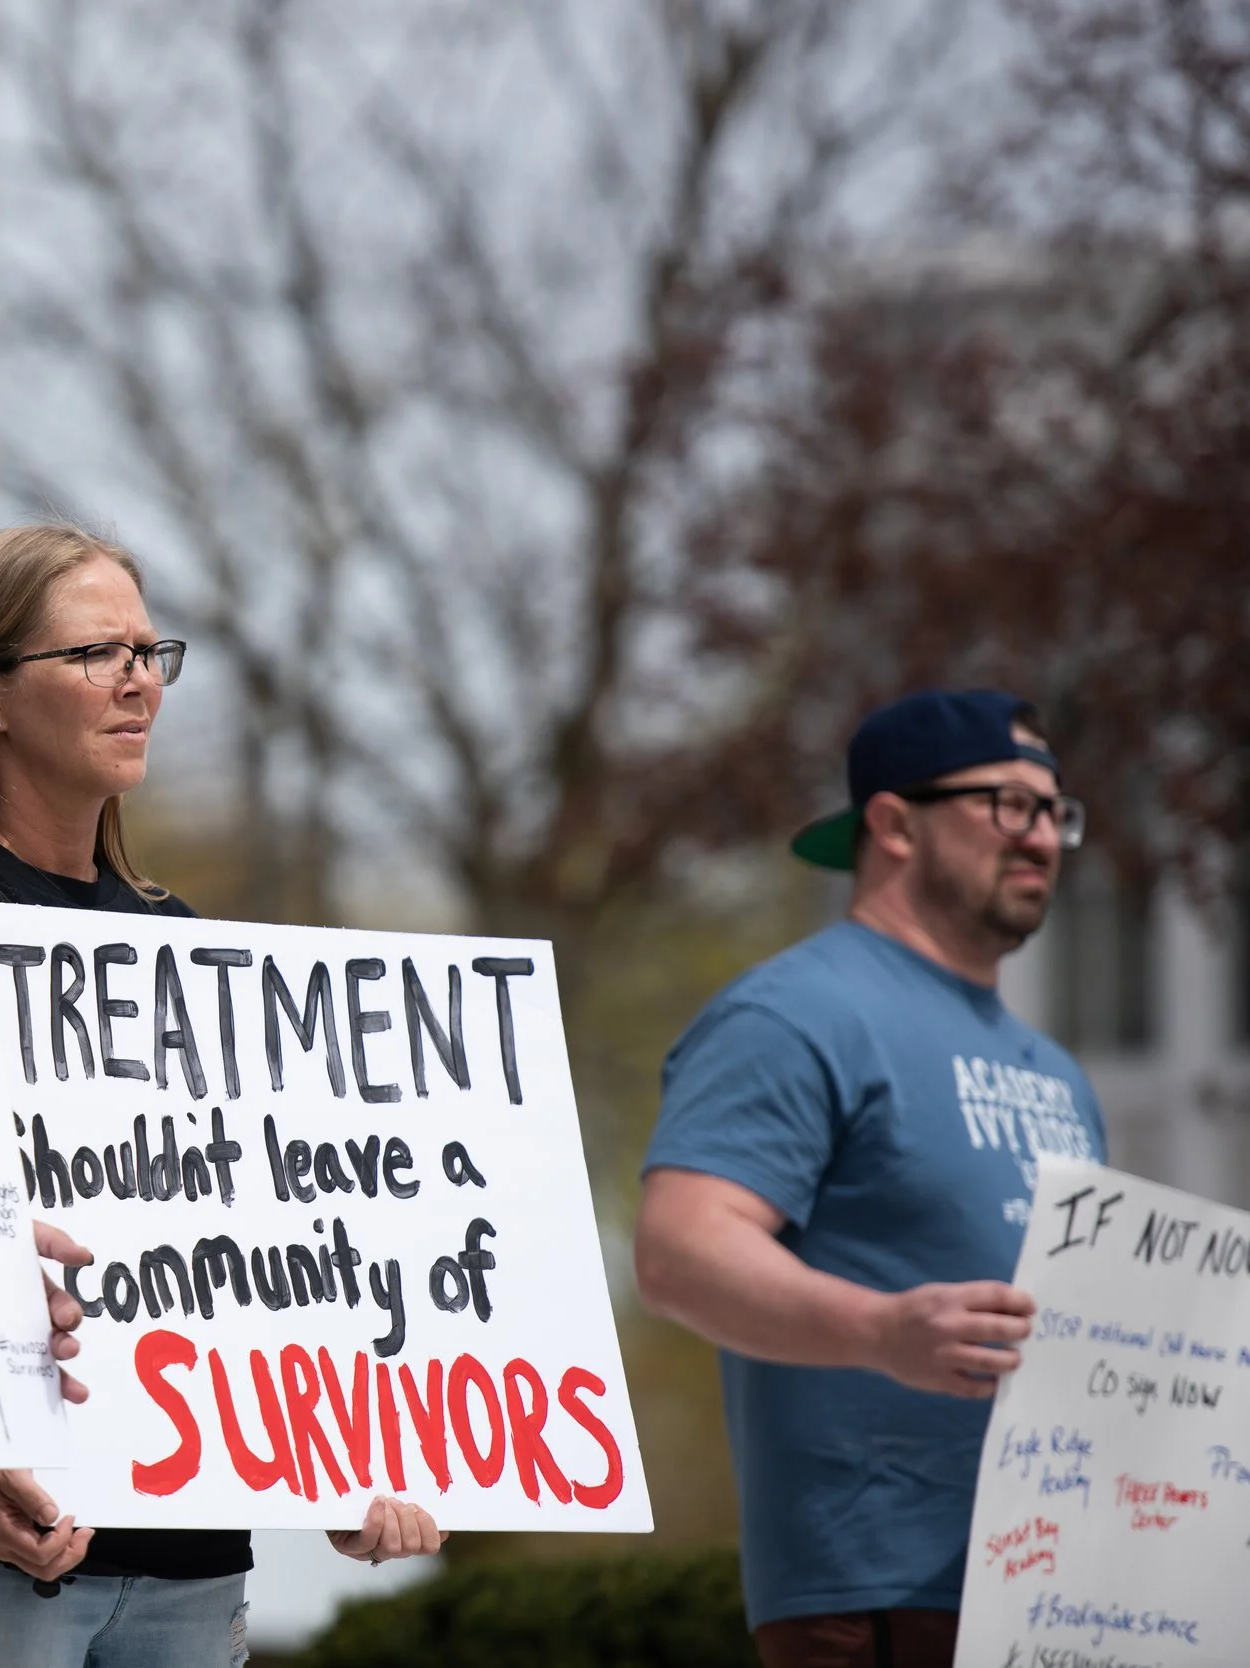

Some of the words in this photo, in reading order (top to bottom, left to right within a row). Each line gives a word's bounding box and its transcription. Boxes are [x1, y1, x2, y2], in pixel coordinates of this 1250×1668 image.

[264, 1114, 421, 1204] leave
[442, 1140, 488, 1190] a
[1047, 1185, 1125, 1258] IF
[1133, 1208, 1200, 1266] NOT
[63, 1216, 407, 1359] community
[428, 1217, 497, 1324] of
[131, 1330, 624, 1510] SURVIVORS
[1170, 1372, 1224, 1411] NOW
